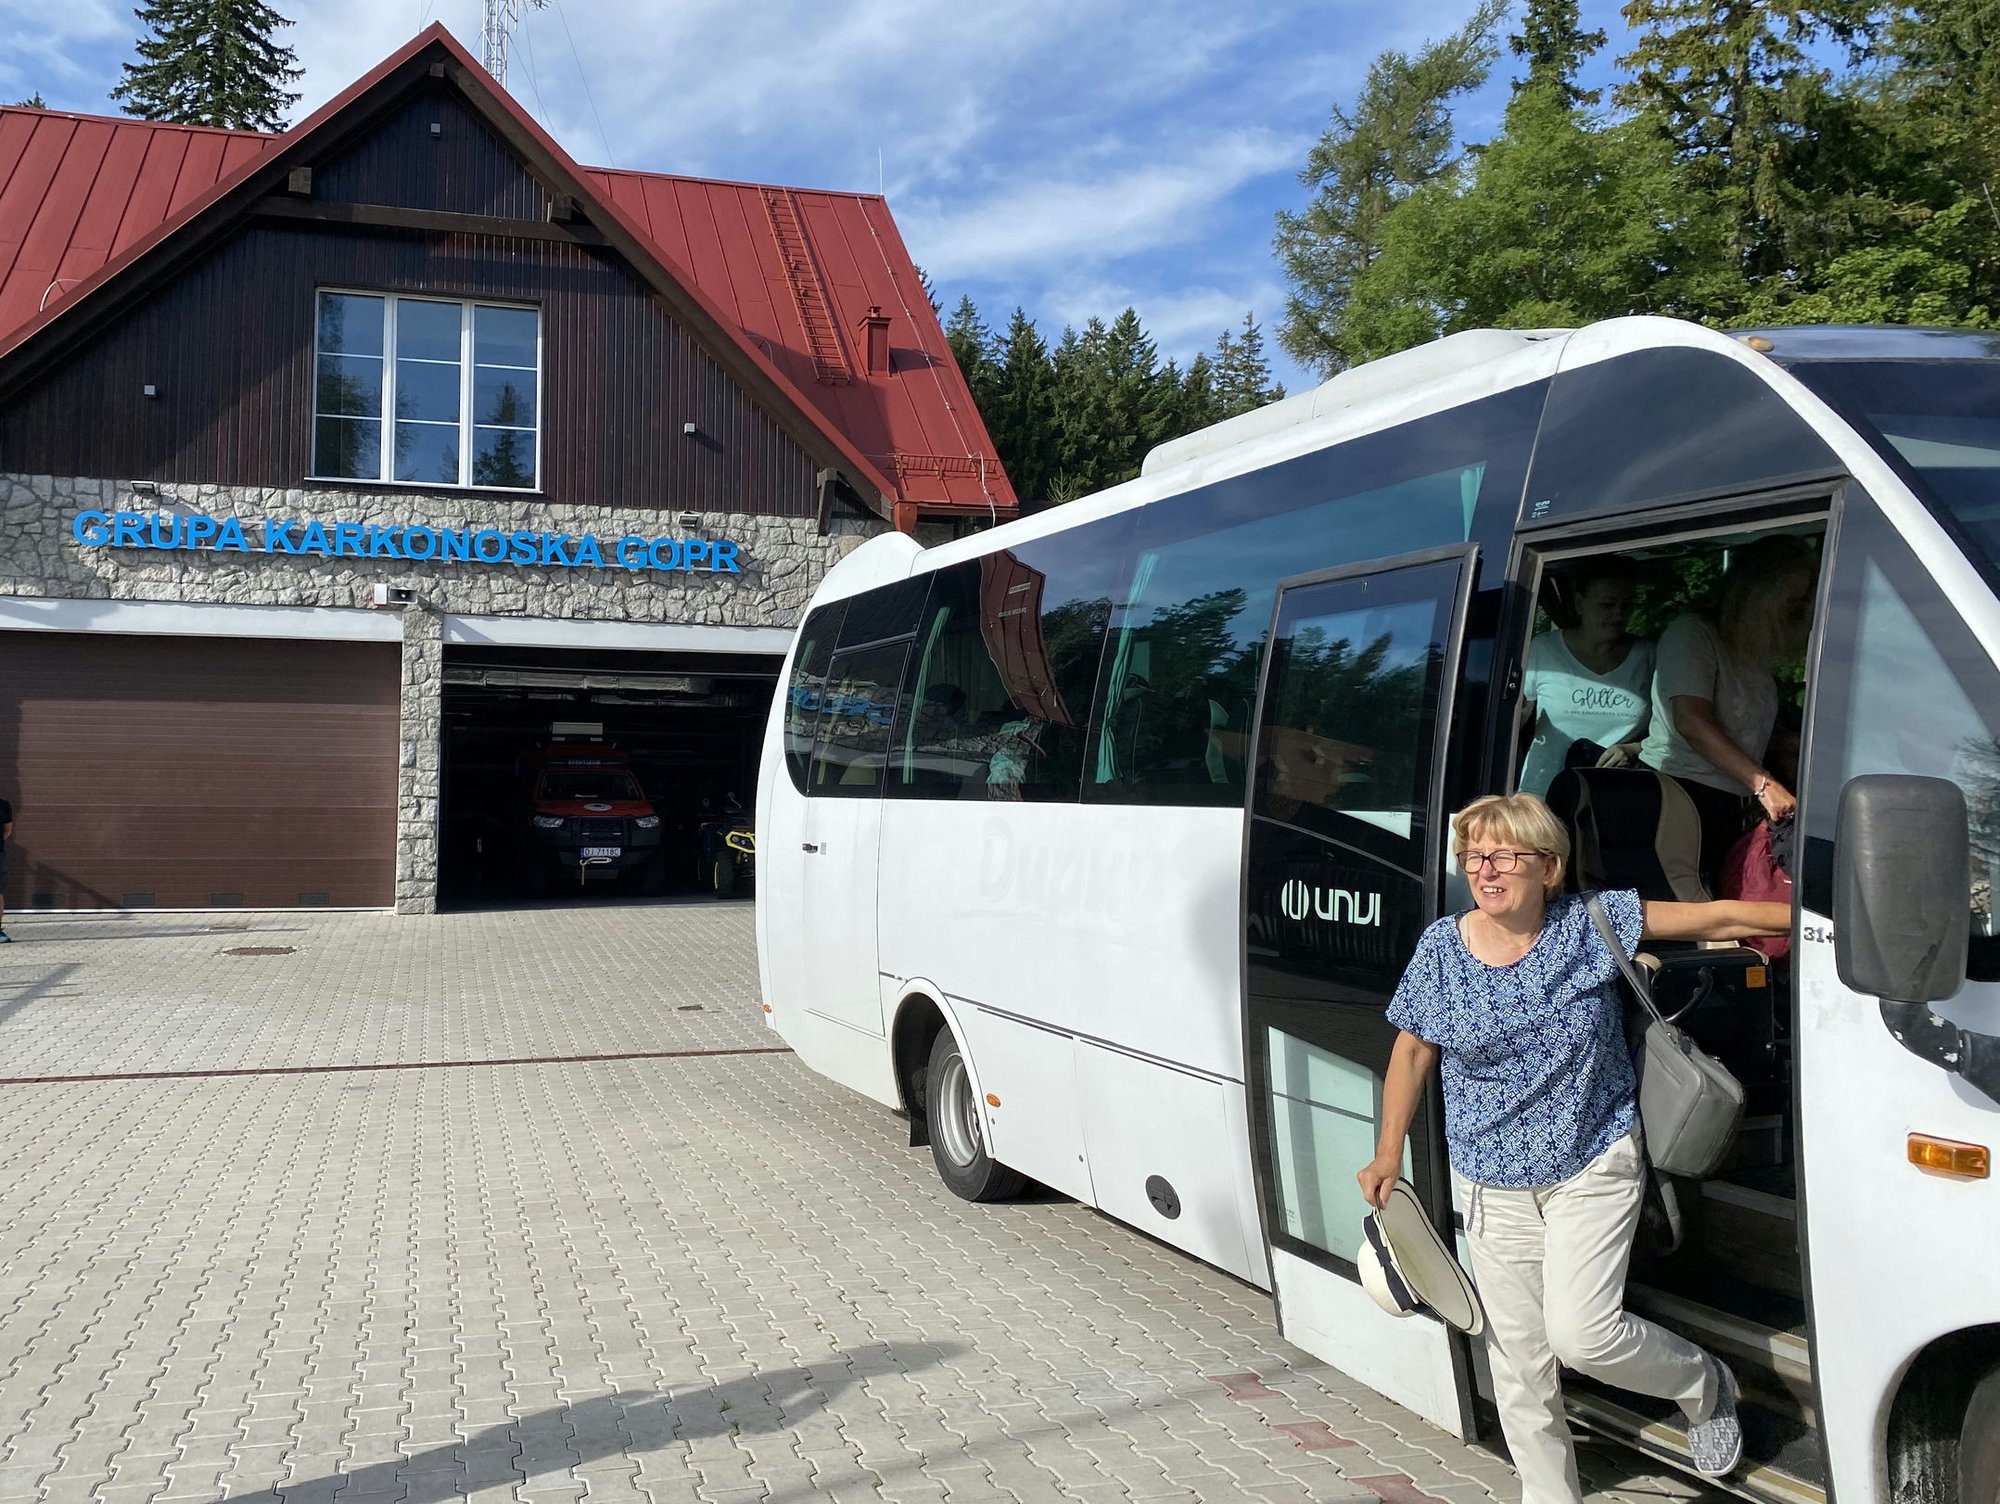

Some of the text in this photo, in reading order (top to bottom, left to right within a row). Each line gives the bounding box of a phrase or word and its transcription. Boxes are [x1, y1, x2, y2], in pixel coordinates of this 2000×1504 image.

[73, 510, 740, 573] GRUPA KARKONOSKA GOPR
[1572, 686, 1635, 709] Glitter
